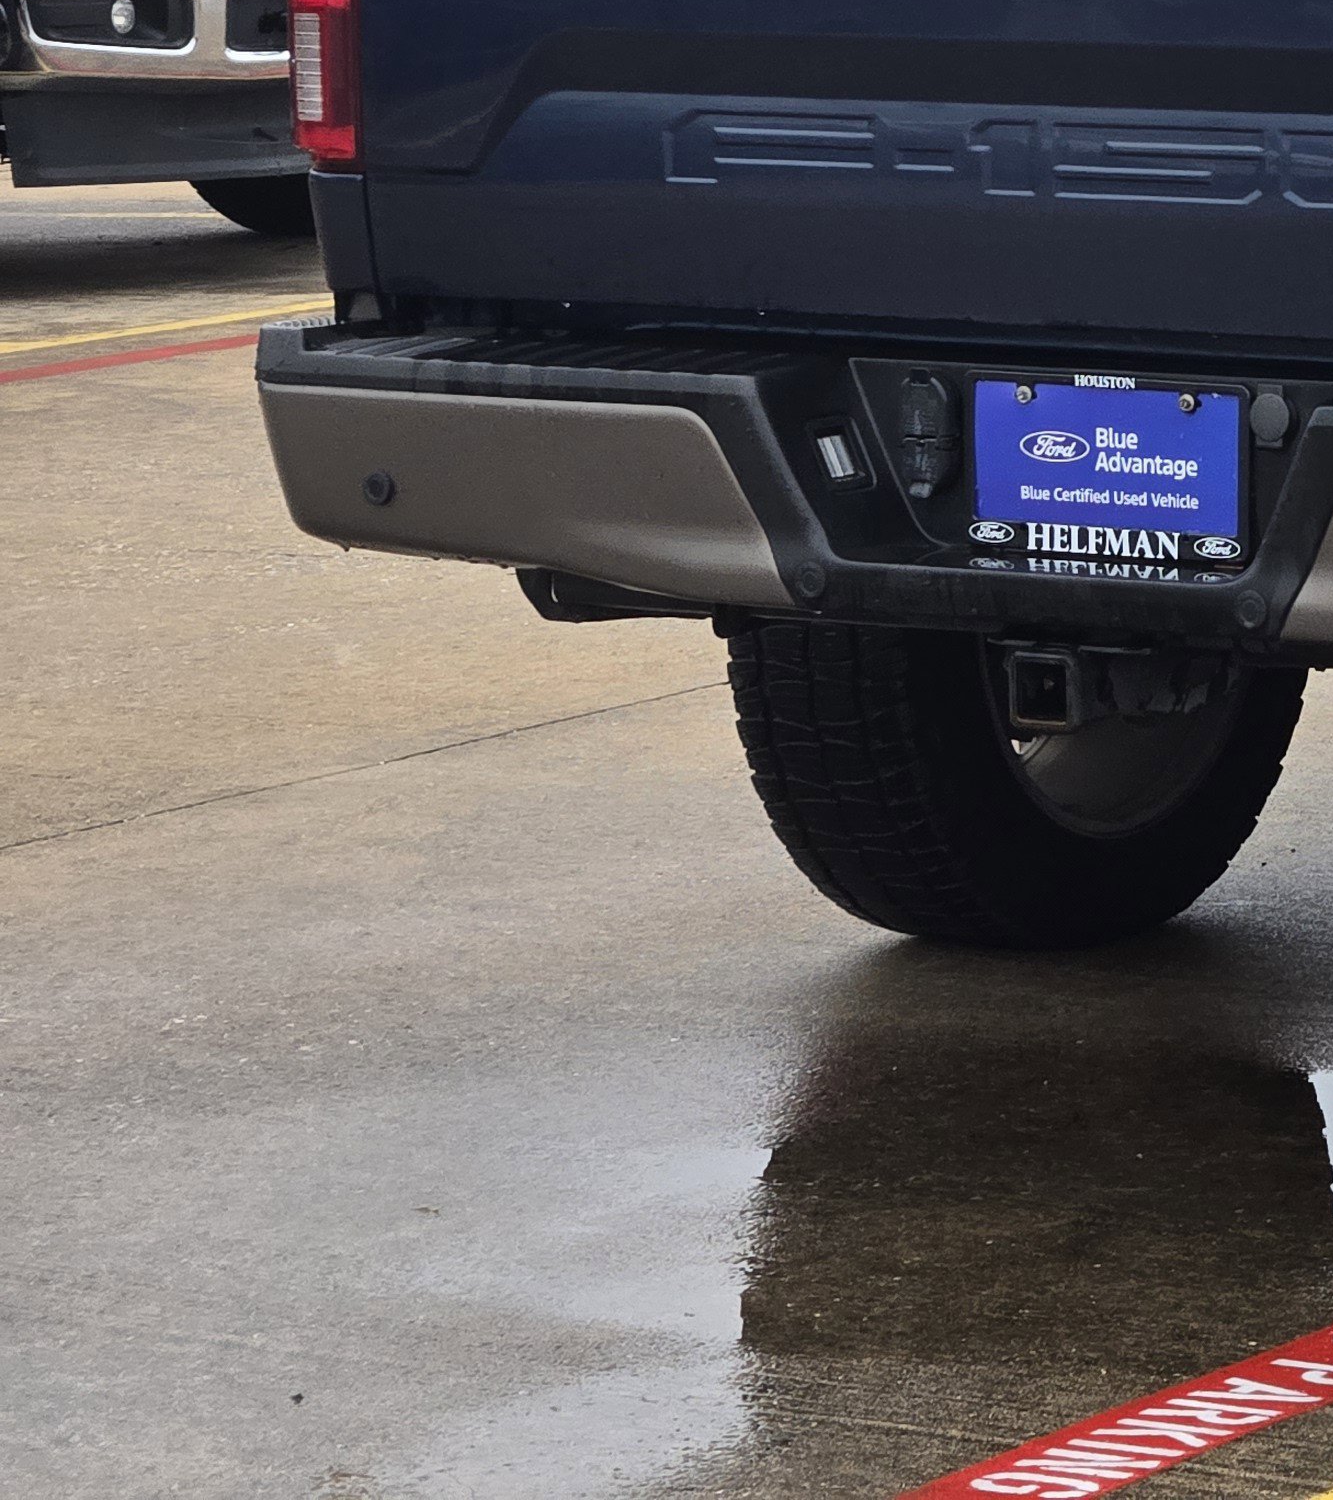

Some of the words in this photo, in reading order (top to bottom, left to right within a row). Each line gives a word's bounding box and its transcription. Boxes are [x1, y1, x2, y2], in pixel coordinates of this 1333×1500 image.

[1074, 374, 1136, 390] HOUSTON
[1095, 427, 1138, 450] Blue
[1095, 451, 1198, 480] Advantage
[1020, 485, 1050, 501] Blue
[1053, 487, 1110, 504] Certified
[1113, 490, 1148, 507] Used
[1151, 492, 1199, 510] Vehicle
[1026, 522, 1181, 560] HELFMAN
